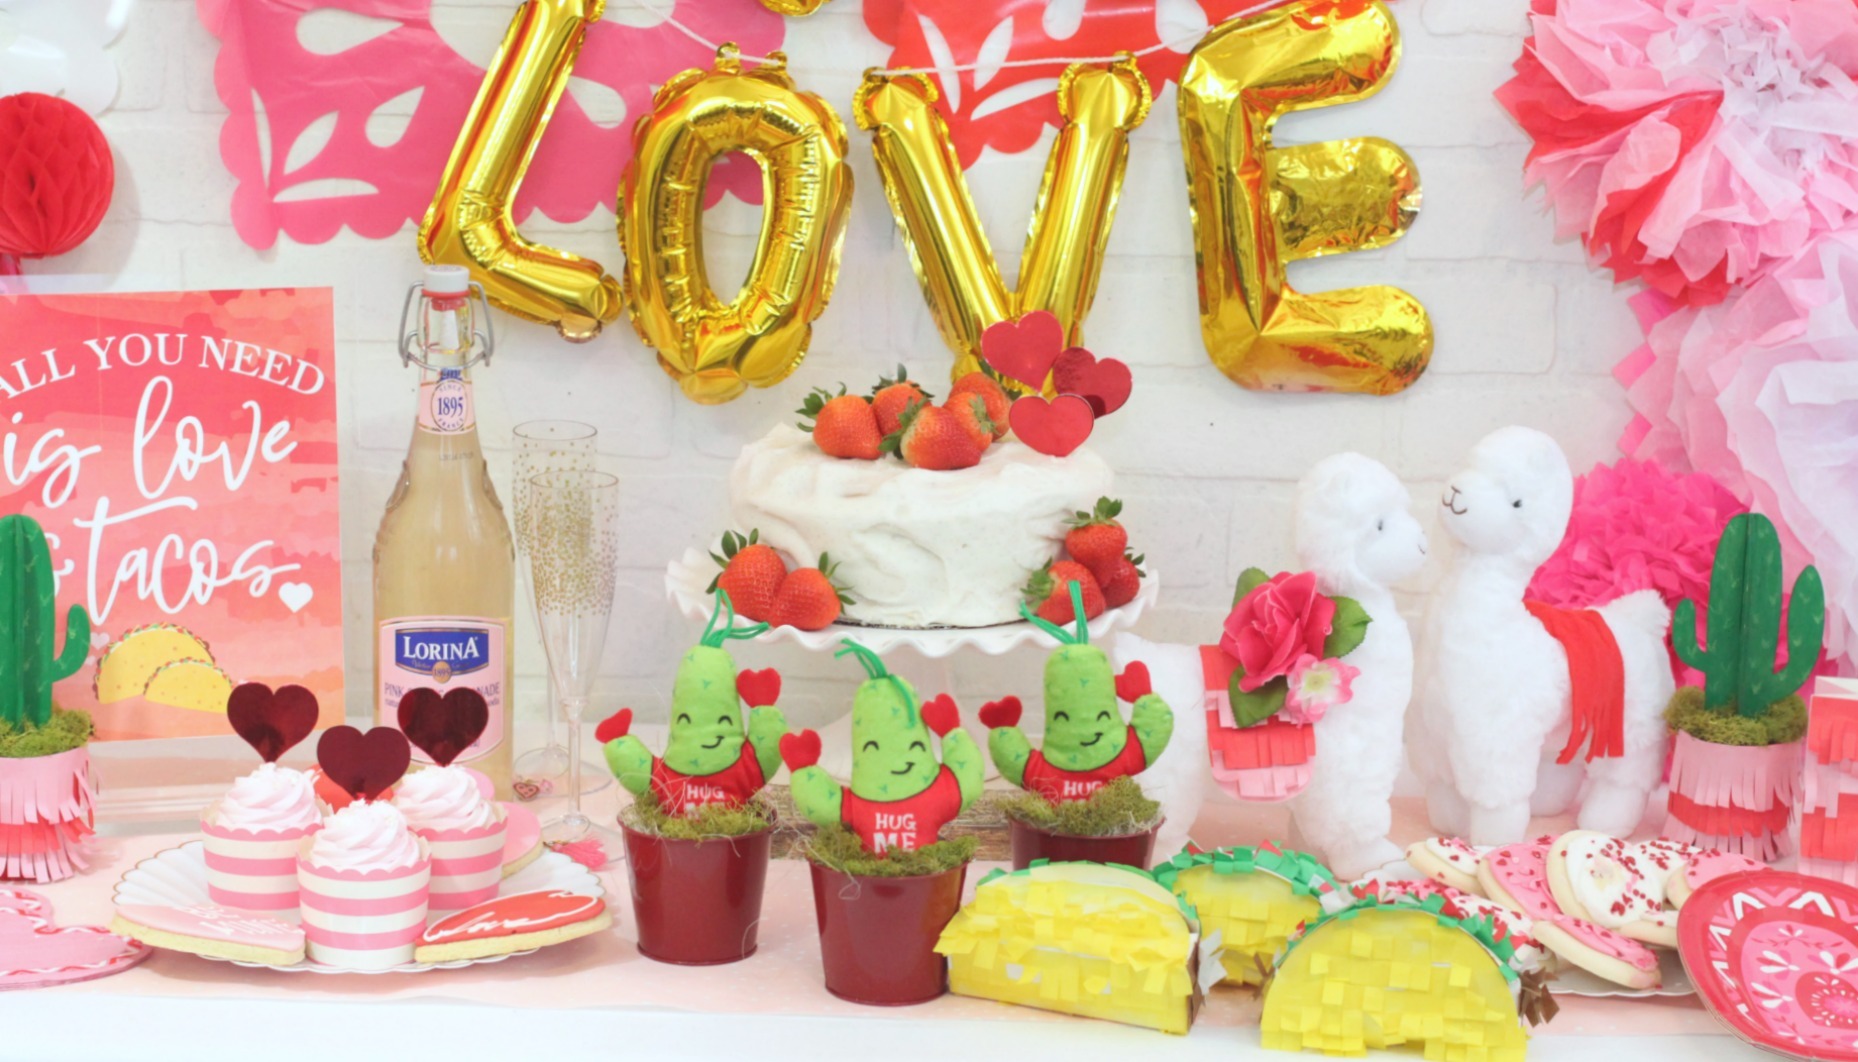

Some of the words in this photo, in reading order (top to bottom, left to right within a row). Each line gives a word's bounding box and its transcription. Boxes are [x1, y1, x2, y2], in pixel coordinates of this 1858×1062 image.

[418, 0, 1436, 404] LOVE
[83, 332, 188, 371] YOU
[198, 335, 325, 396] NEED
[437, 397, 464, 418] 1895
[3, 411, 102, 509] is
[132, 375, 298, 499] love
[73, 496, 302, 626] tacos
[403, 635, 480, 661] LORINA
[686, 784, 725, 800] HUG
[875, 812, 917, 831] HUG
[873, 832, 917, 854] ME
